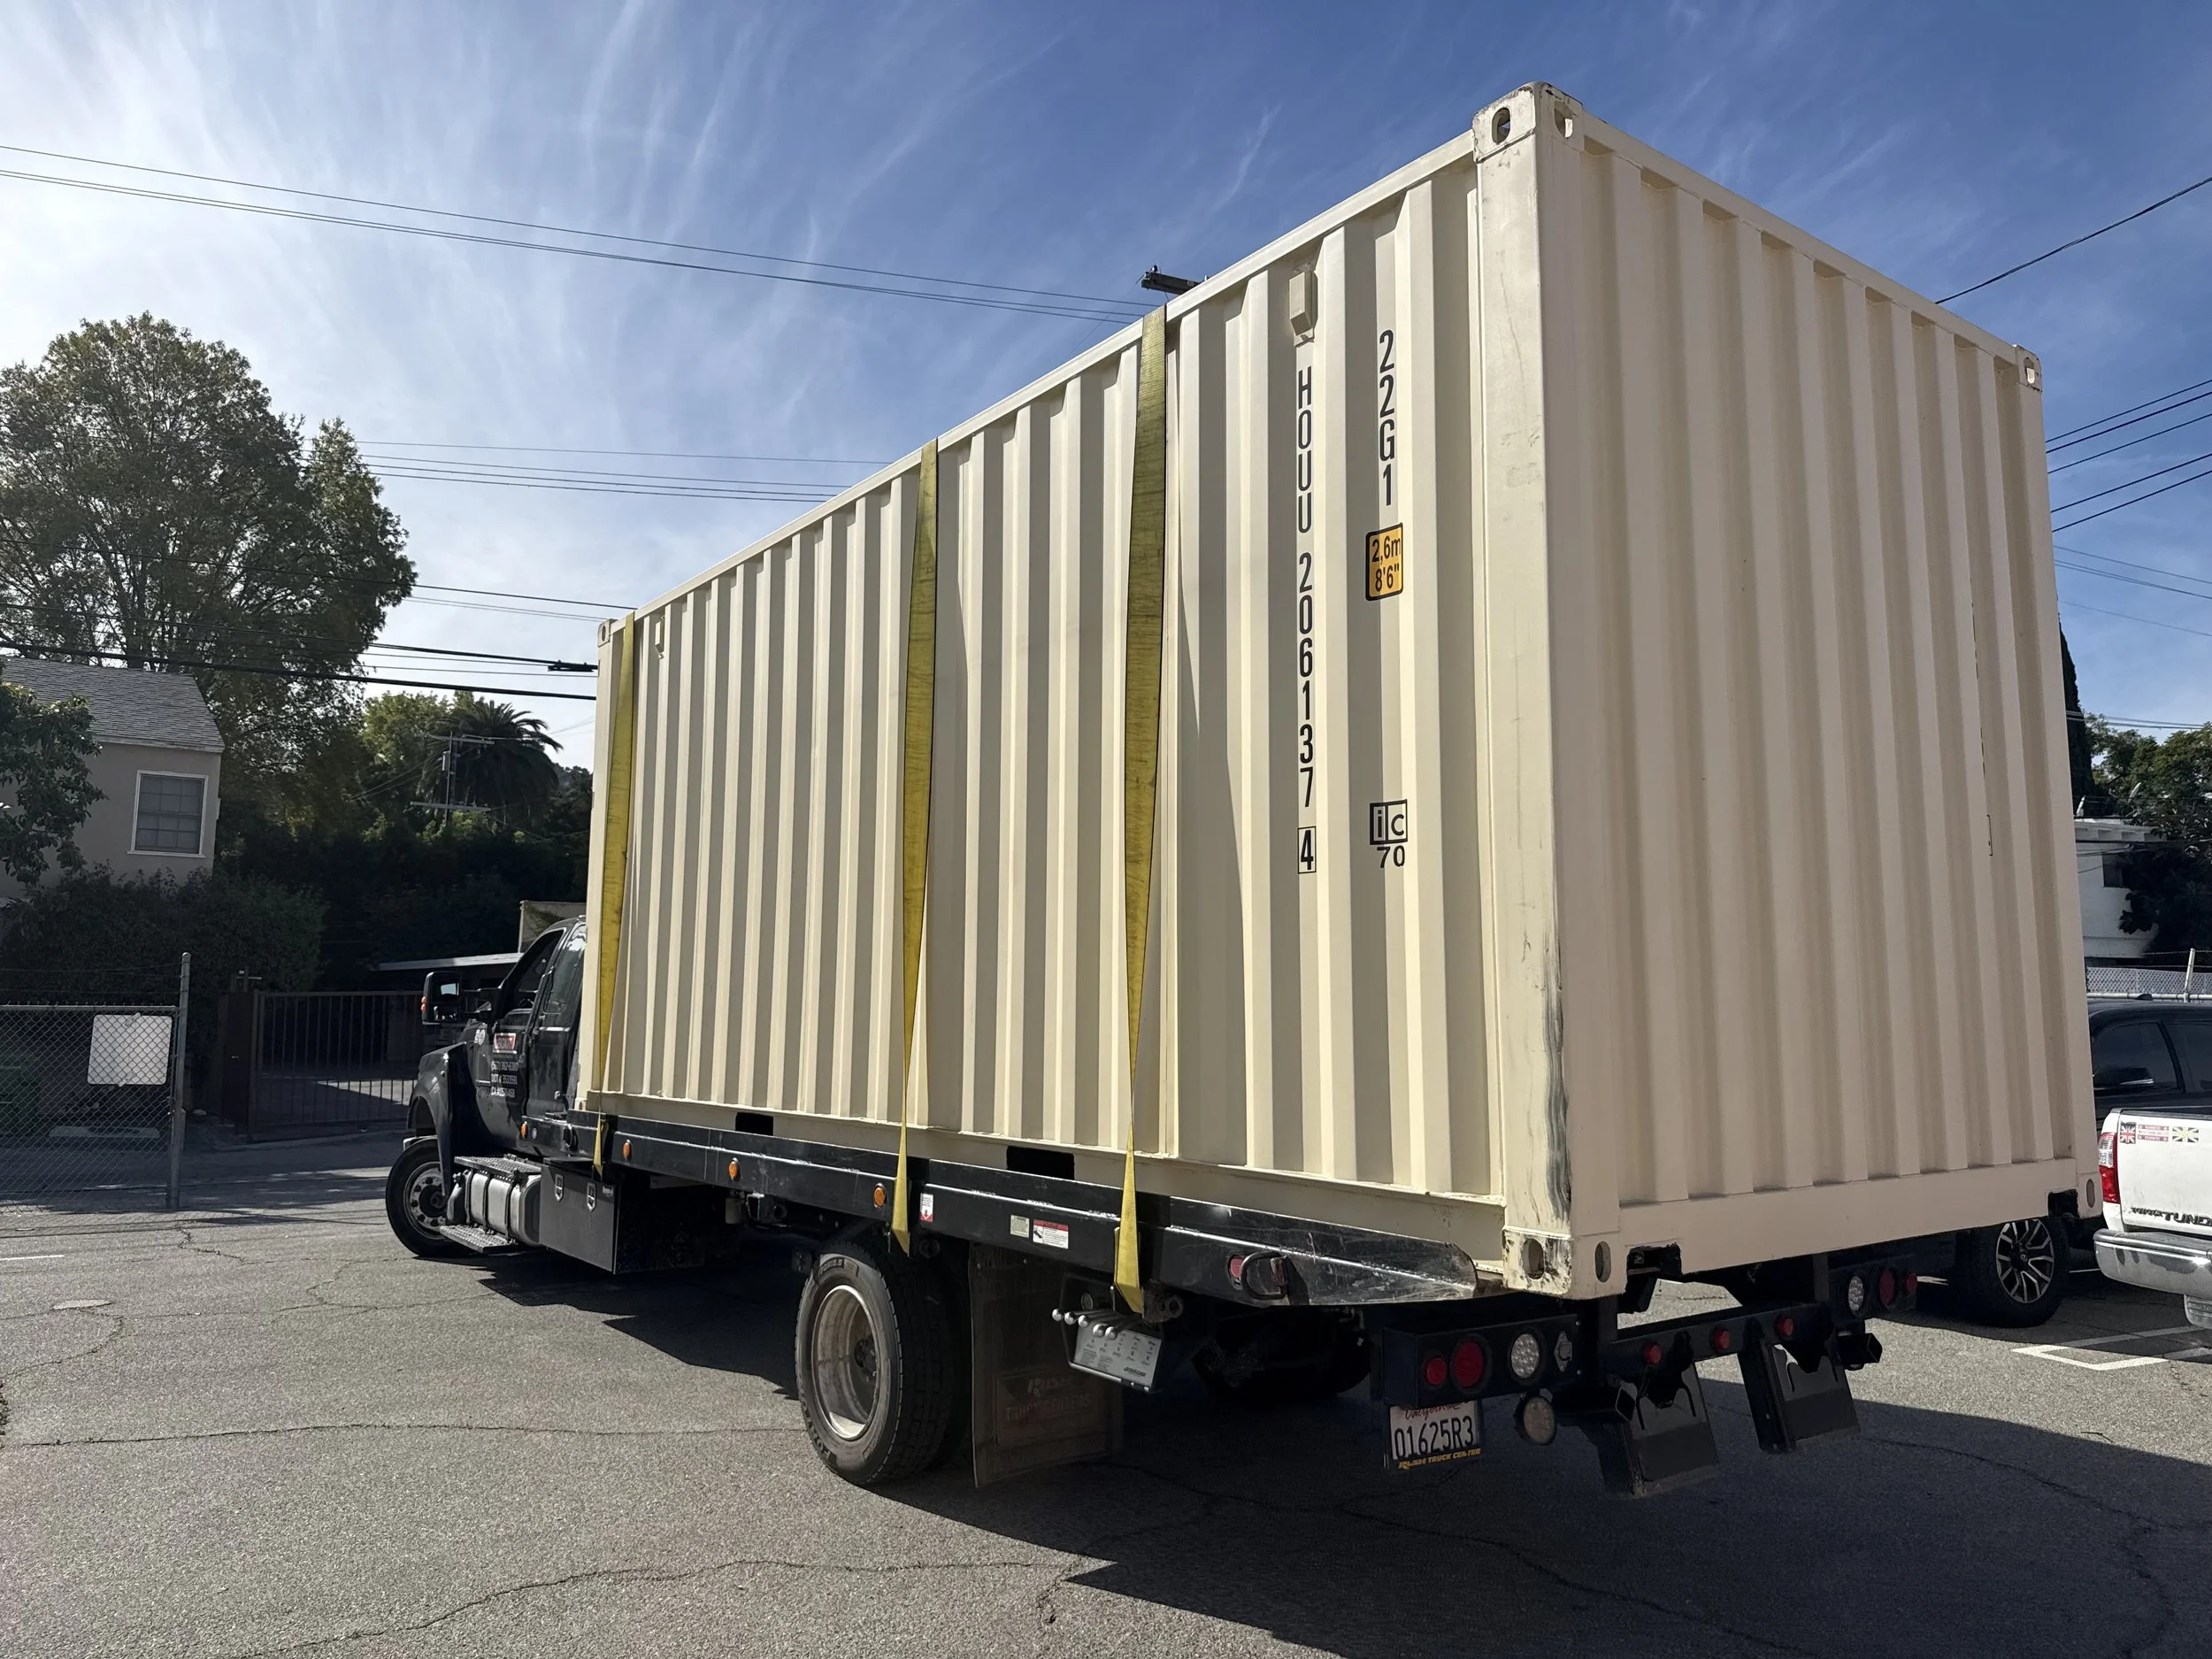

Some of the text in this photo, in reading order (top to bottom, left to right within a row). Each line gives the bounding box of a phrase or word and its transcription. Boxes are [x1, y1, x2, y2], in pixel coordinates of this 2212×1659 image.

[1379, 329, 1395, 506] 22G1
[1371, 535, 1401, 565] 2,6m
[1375, 563, 1400, 592] 8'6"
[1298, 365, 1314, 870] HOUU 206137 4
[1377, 845, 1405, 868] 70
[2161, 1211, 2212, 1227] TUND
[1394, 1416, 1474, 1458] 01625R3
[1427, 1453, 1452, 1463] TRUCK
